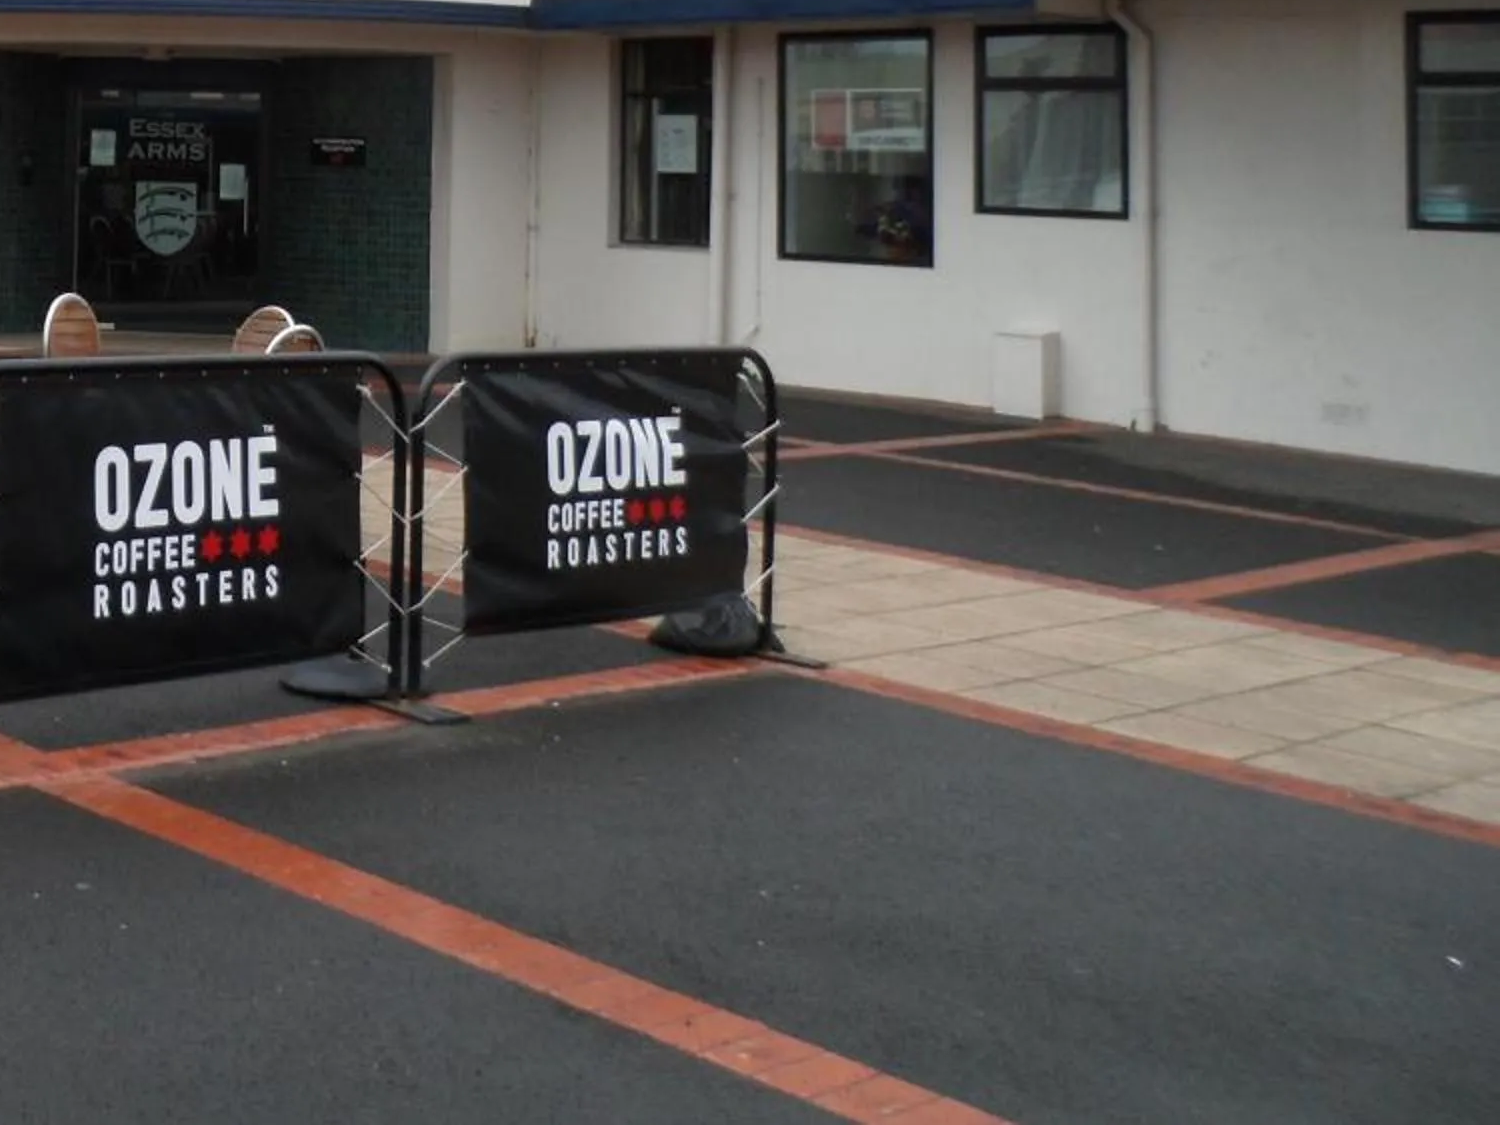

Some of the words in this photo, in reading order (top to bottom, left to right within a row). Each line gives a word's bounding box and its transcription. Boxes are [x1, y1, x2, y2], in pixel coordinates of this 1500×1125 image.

[128, 117, 206, 139] ESSEX
[126, 140, 207, 163] ARMS
[546, 415, 688, 496] OZONE
[94, 434, 280, 533] OZONE
[547, 497, 626, 534] COFFEE
[94, 534, 197, 578] COFFEE
[546, 526, 689, 570] ROASTERS
[93, 564, 280, 619] ROASTERS
